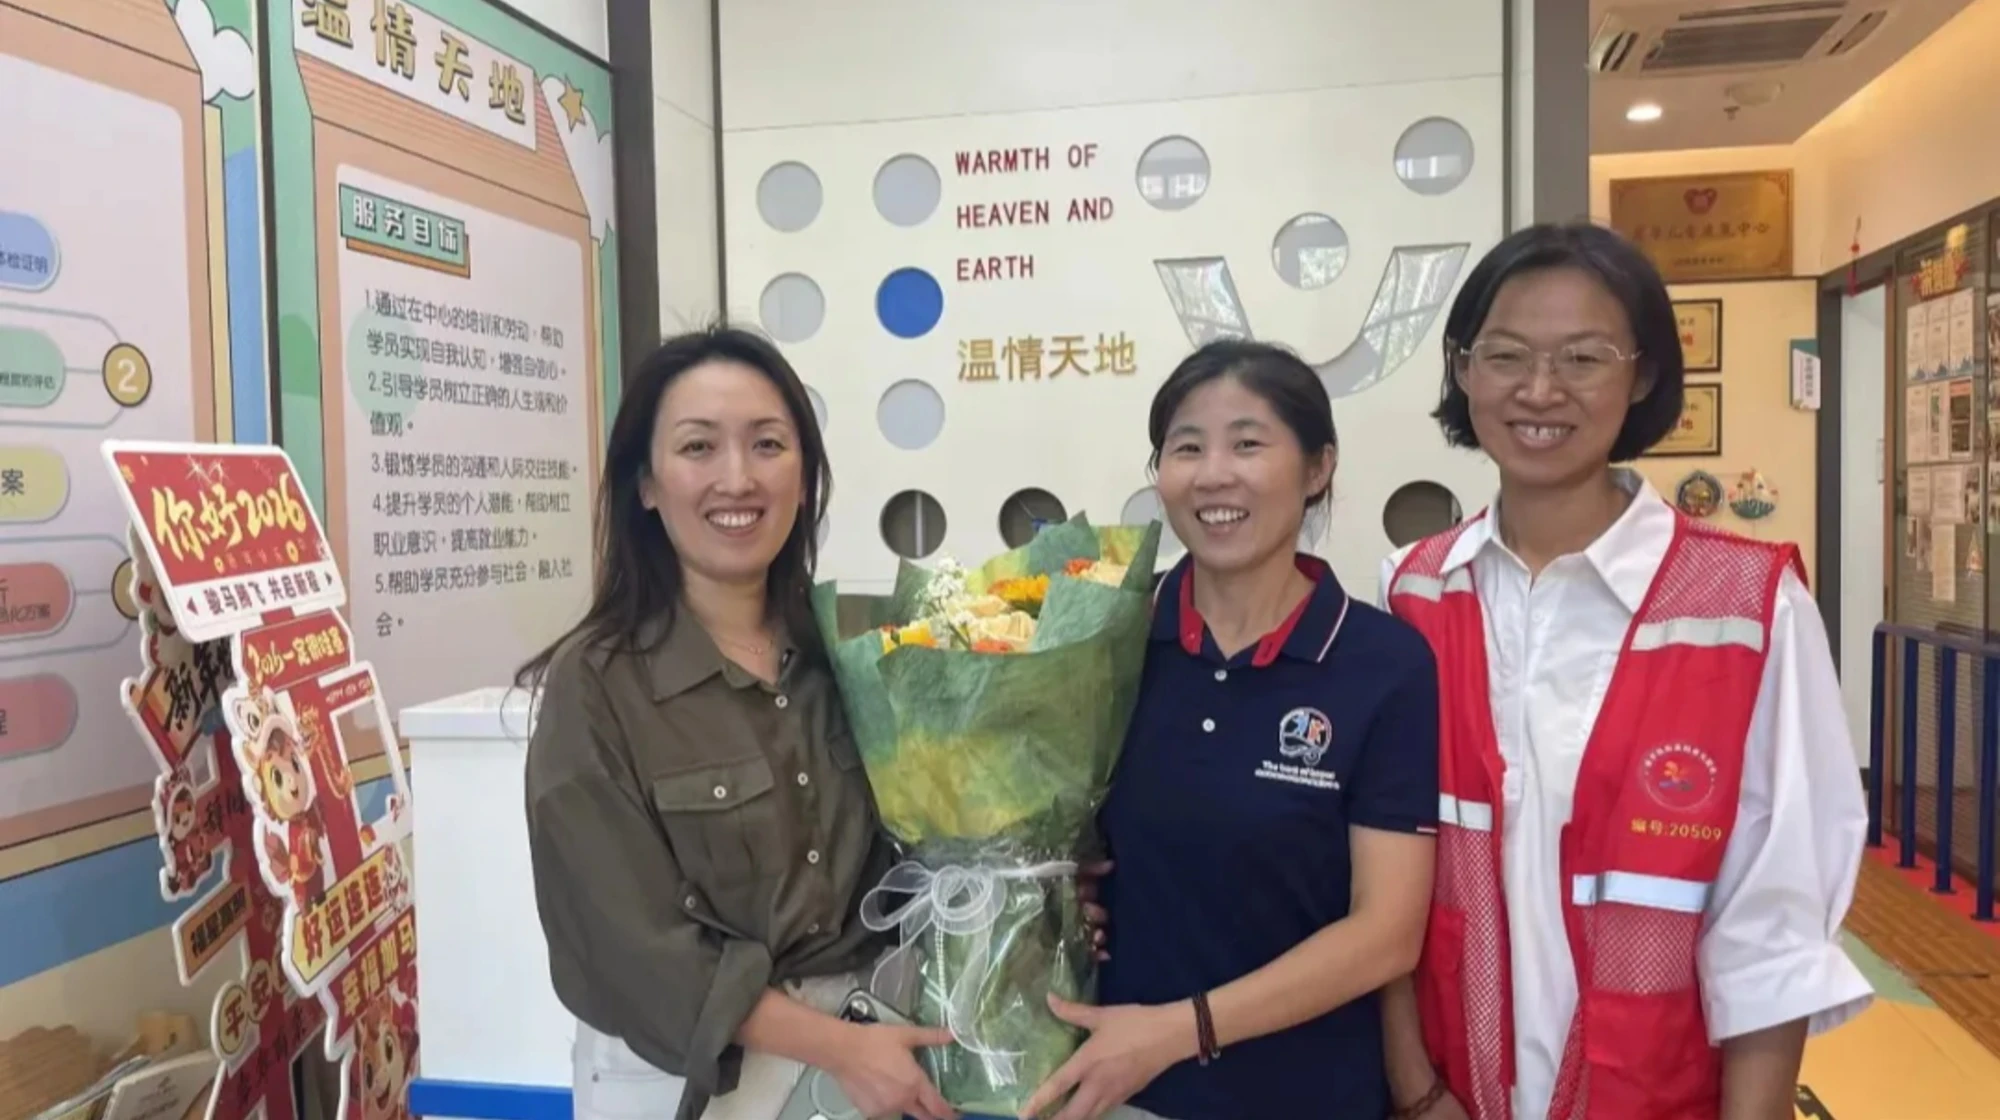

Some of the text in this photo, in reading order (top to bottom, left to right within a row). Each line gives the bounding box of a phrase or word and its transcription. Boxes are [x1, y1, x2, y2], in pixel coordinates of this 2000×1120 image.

[955, 143, 1098, 176] WARMTH OF
[353, 194, 459, 256] 服务目标
[956, 196, 1114, 230] HEAVEN AND
[956, 254, 1035, 282] EARTH
[957, 331, 1138, 383] 温情天地
[117, 358, 138, 393] 2
[1, 468, 25, 497] 案
[151, 471, 307, 563] 你好2026
[1630, 818, 1722, 841] 编号:20509
[303, 864, 385, 967] 好运连连
